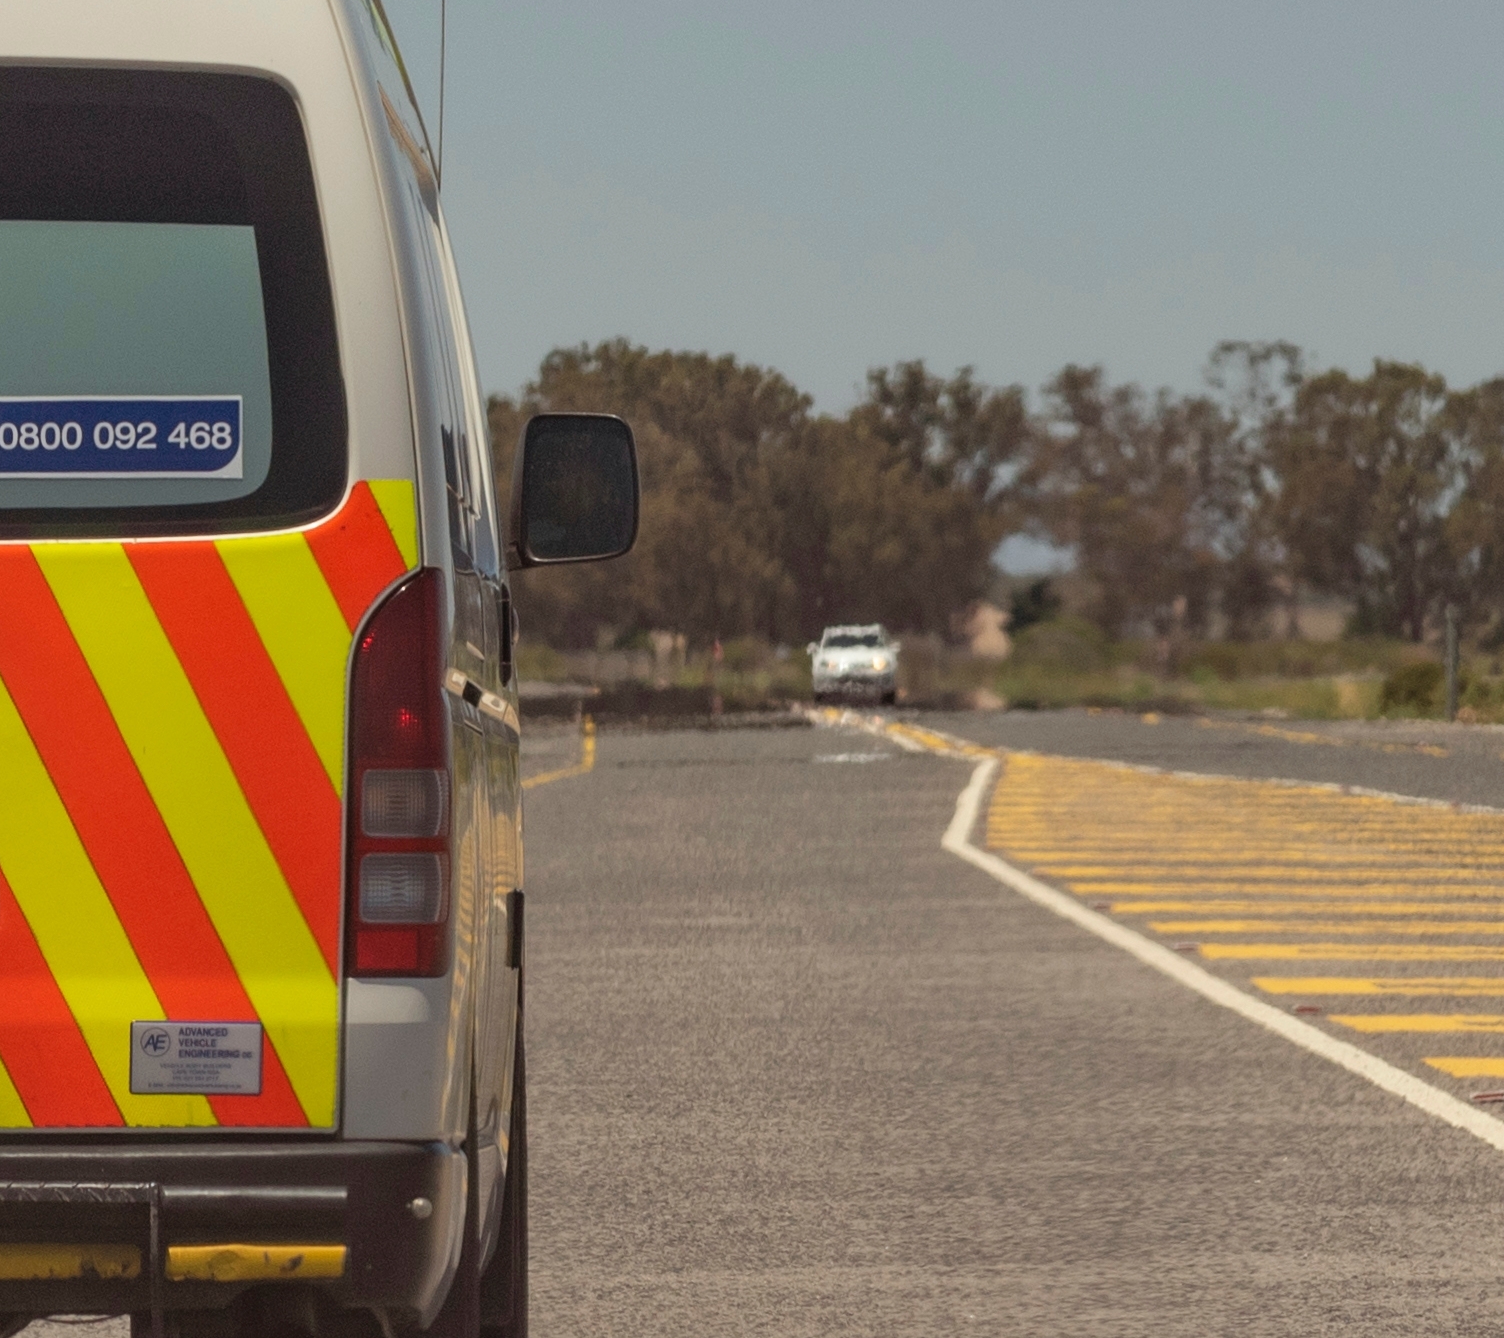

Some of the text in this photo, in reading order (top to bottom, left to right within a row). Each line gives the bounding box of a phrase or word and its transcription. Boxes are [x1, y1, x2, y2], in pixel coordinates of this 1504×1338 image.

[93, 421, 158, 451] 092
[167, 421, 233, 451] 468
[178, 1027, 228, 1037] ADVANCED
[178, 1038, 217, 1048] VEHICLE
[178, 1049, 240, 1058] ENGINEERING
